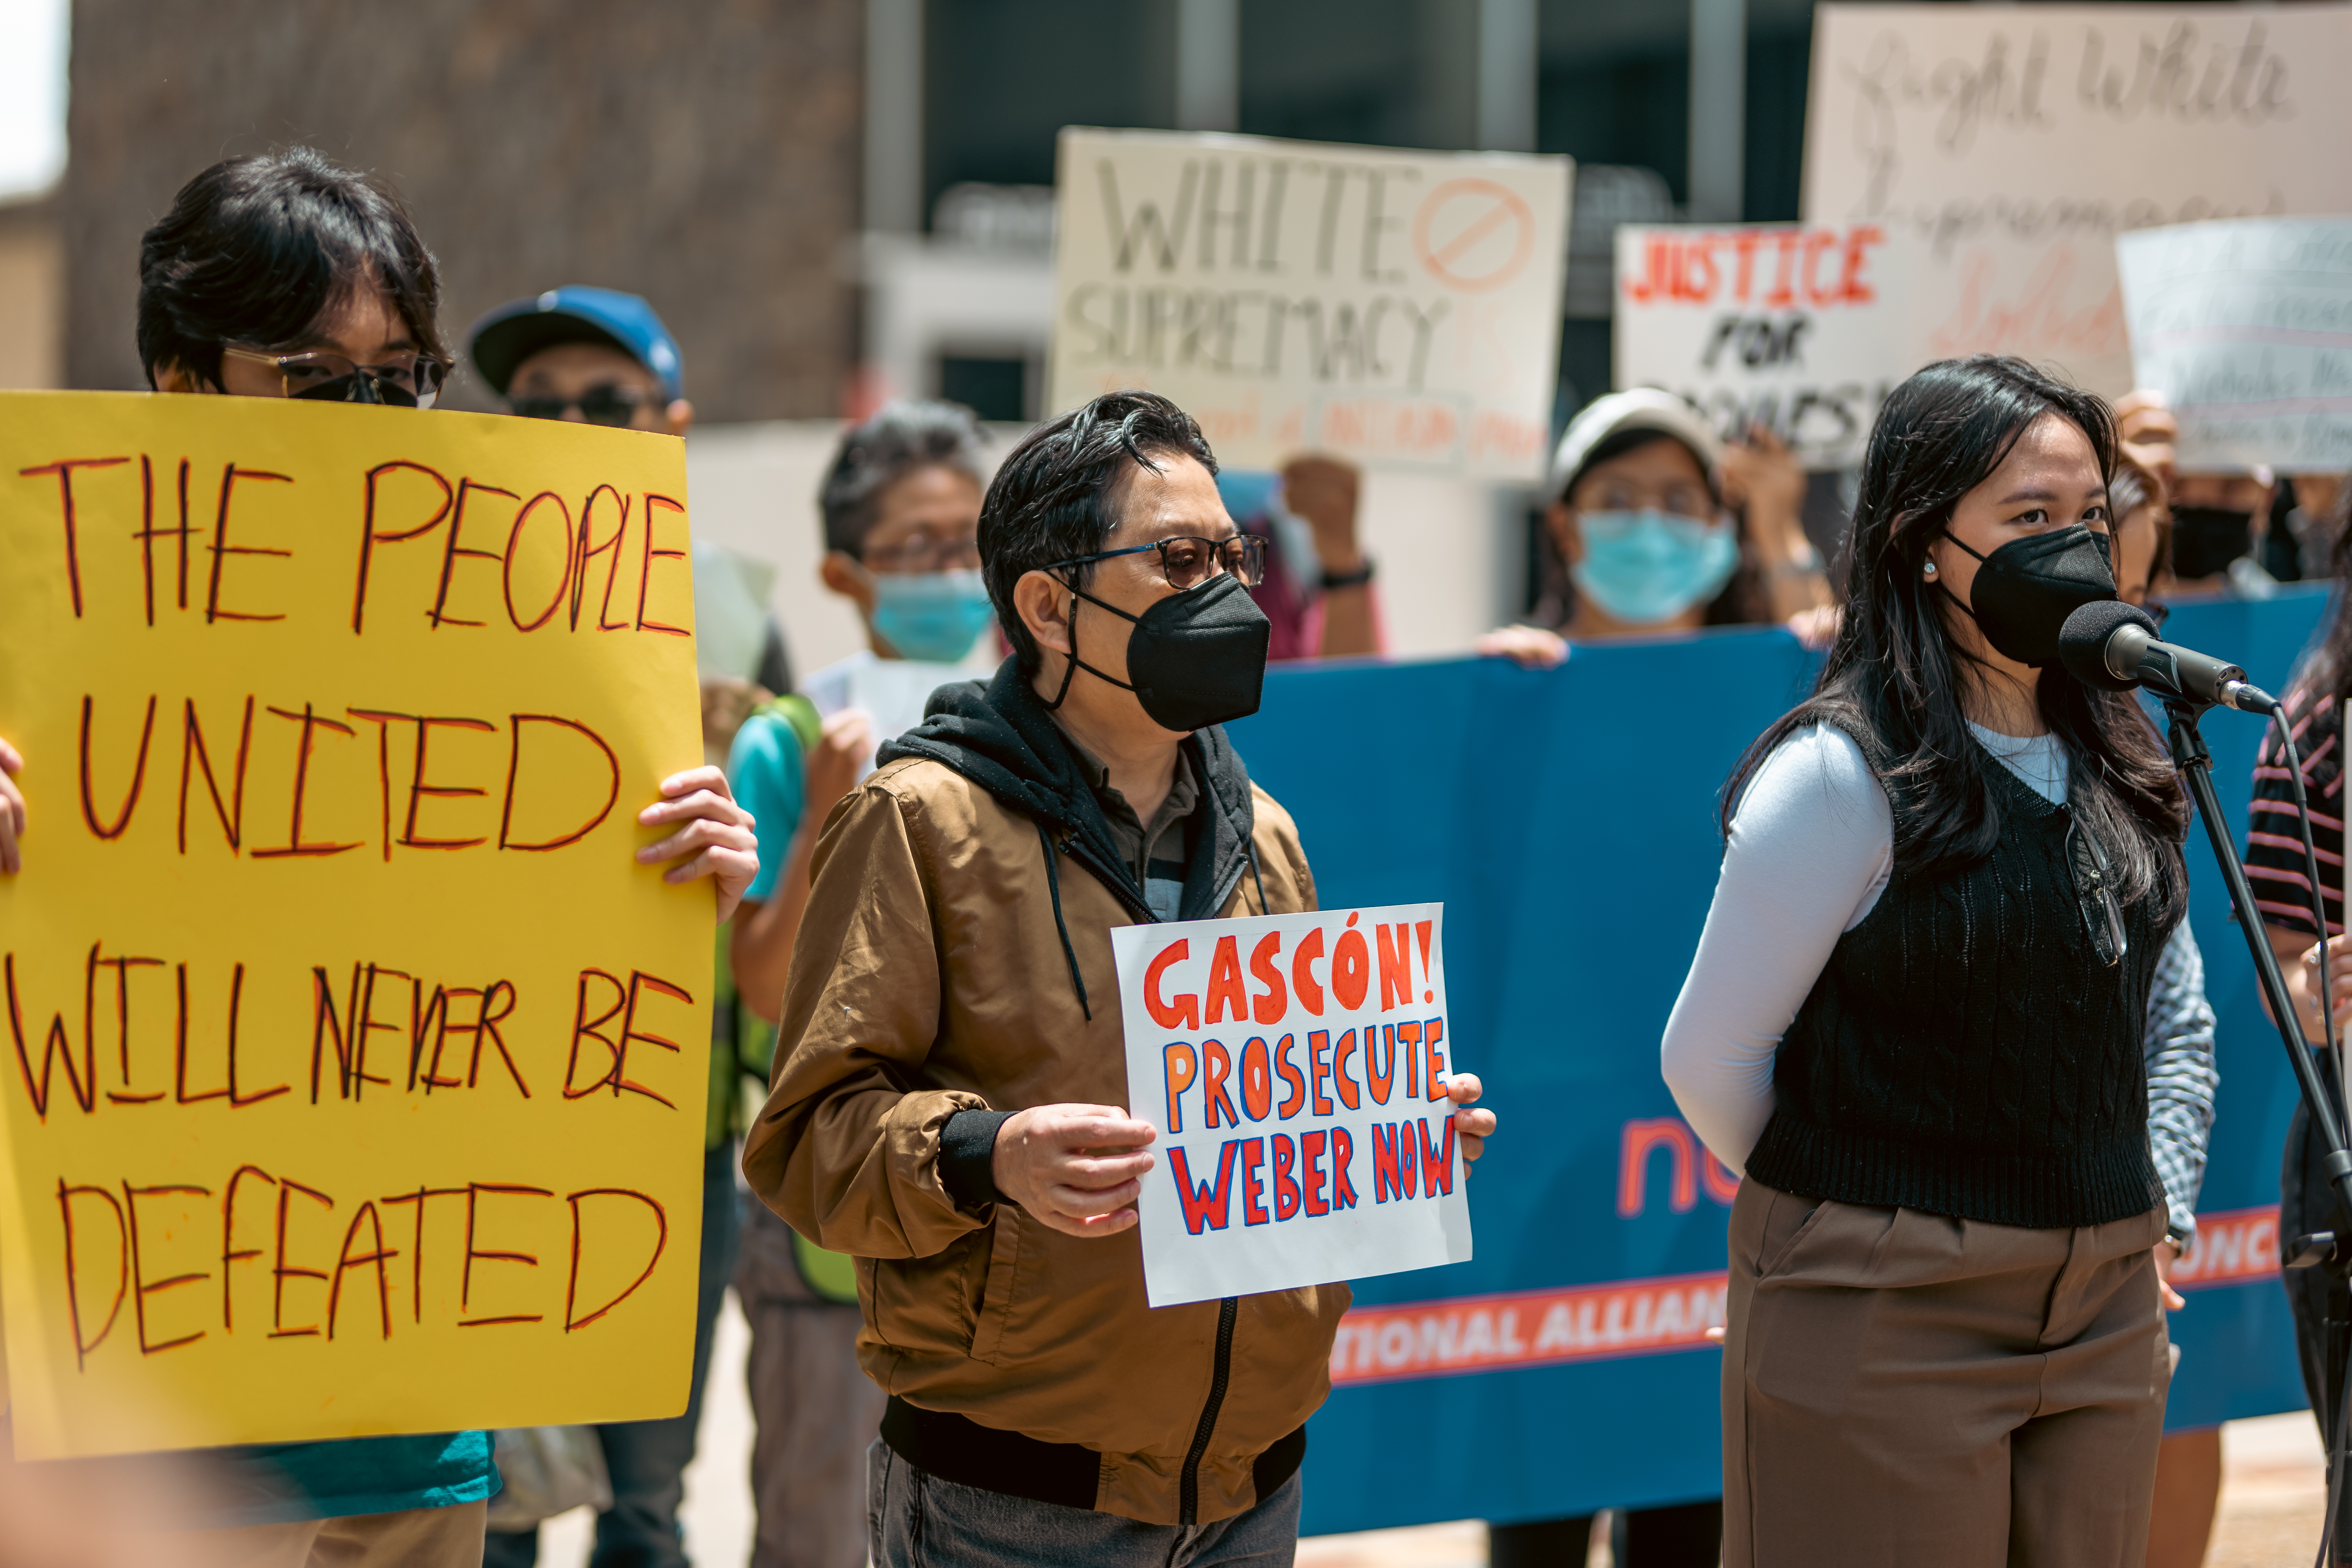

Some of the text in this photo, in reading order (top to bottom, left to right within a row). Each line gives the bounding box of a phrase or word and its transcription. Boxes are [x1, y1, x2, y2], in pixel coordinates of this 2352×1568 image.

[1095, 158, 1423, 283] WHITE
[1622, 225, 1886, 308] JUSTICE
[1063, 281, 1452, 392] SUPREMACY
[1698, 311, 1811, 377] FOR
[19, 454, 691, 635] THE PEOPLE
[80, 694, 621, 861] UNITED
[1144, 911, 1433, 1031] GASCÓN!
[6, 940, 693, 1125] WILL NEVER BE
[1163, 1017, 1448, 1134] PROSECUTE
[1166, 1114, 1455, 1235] WEBER NOW
[57, 1164, 667, 1372] DEFEATED
